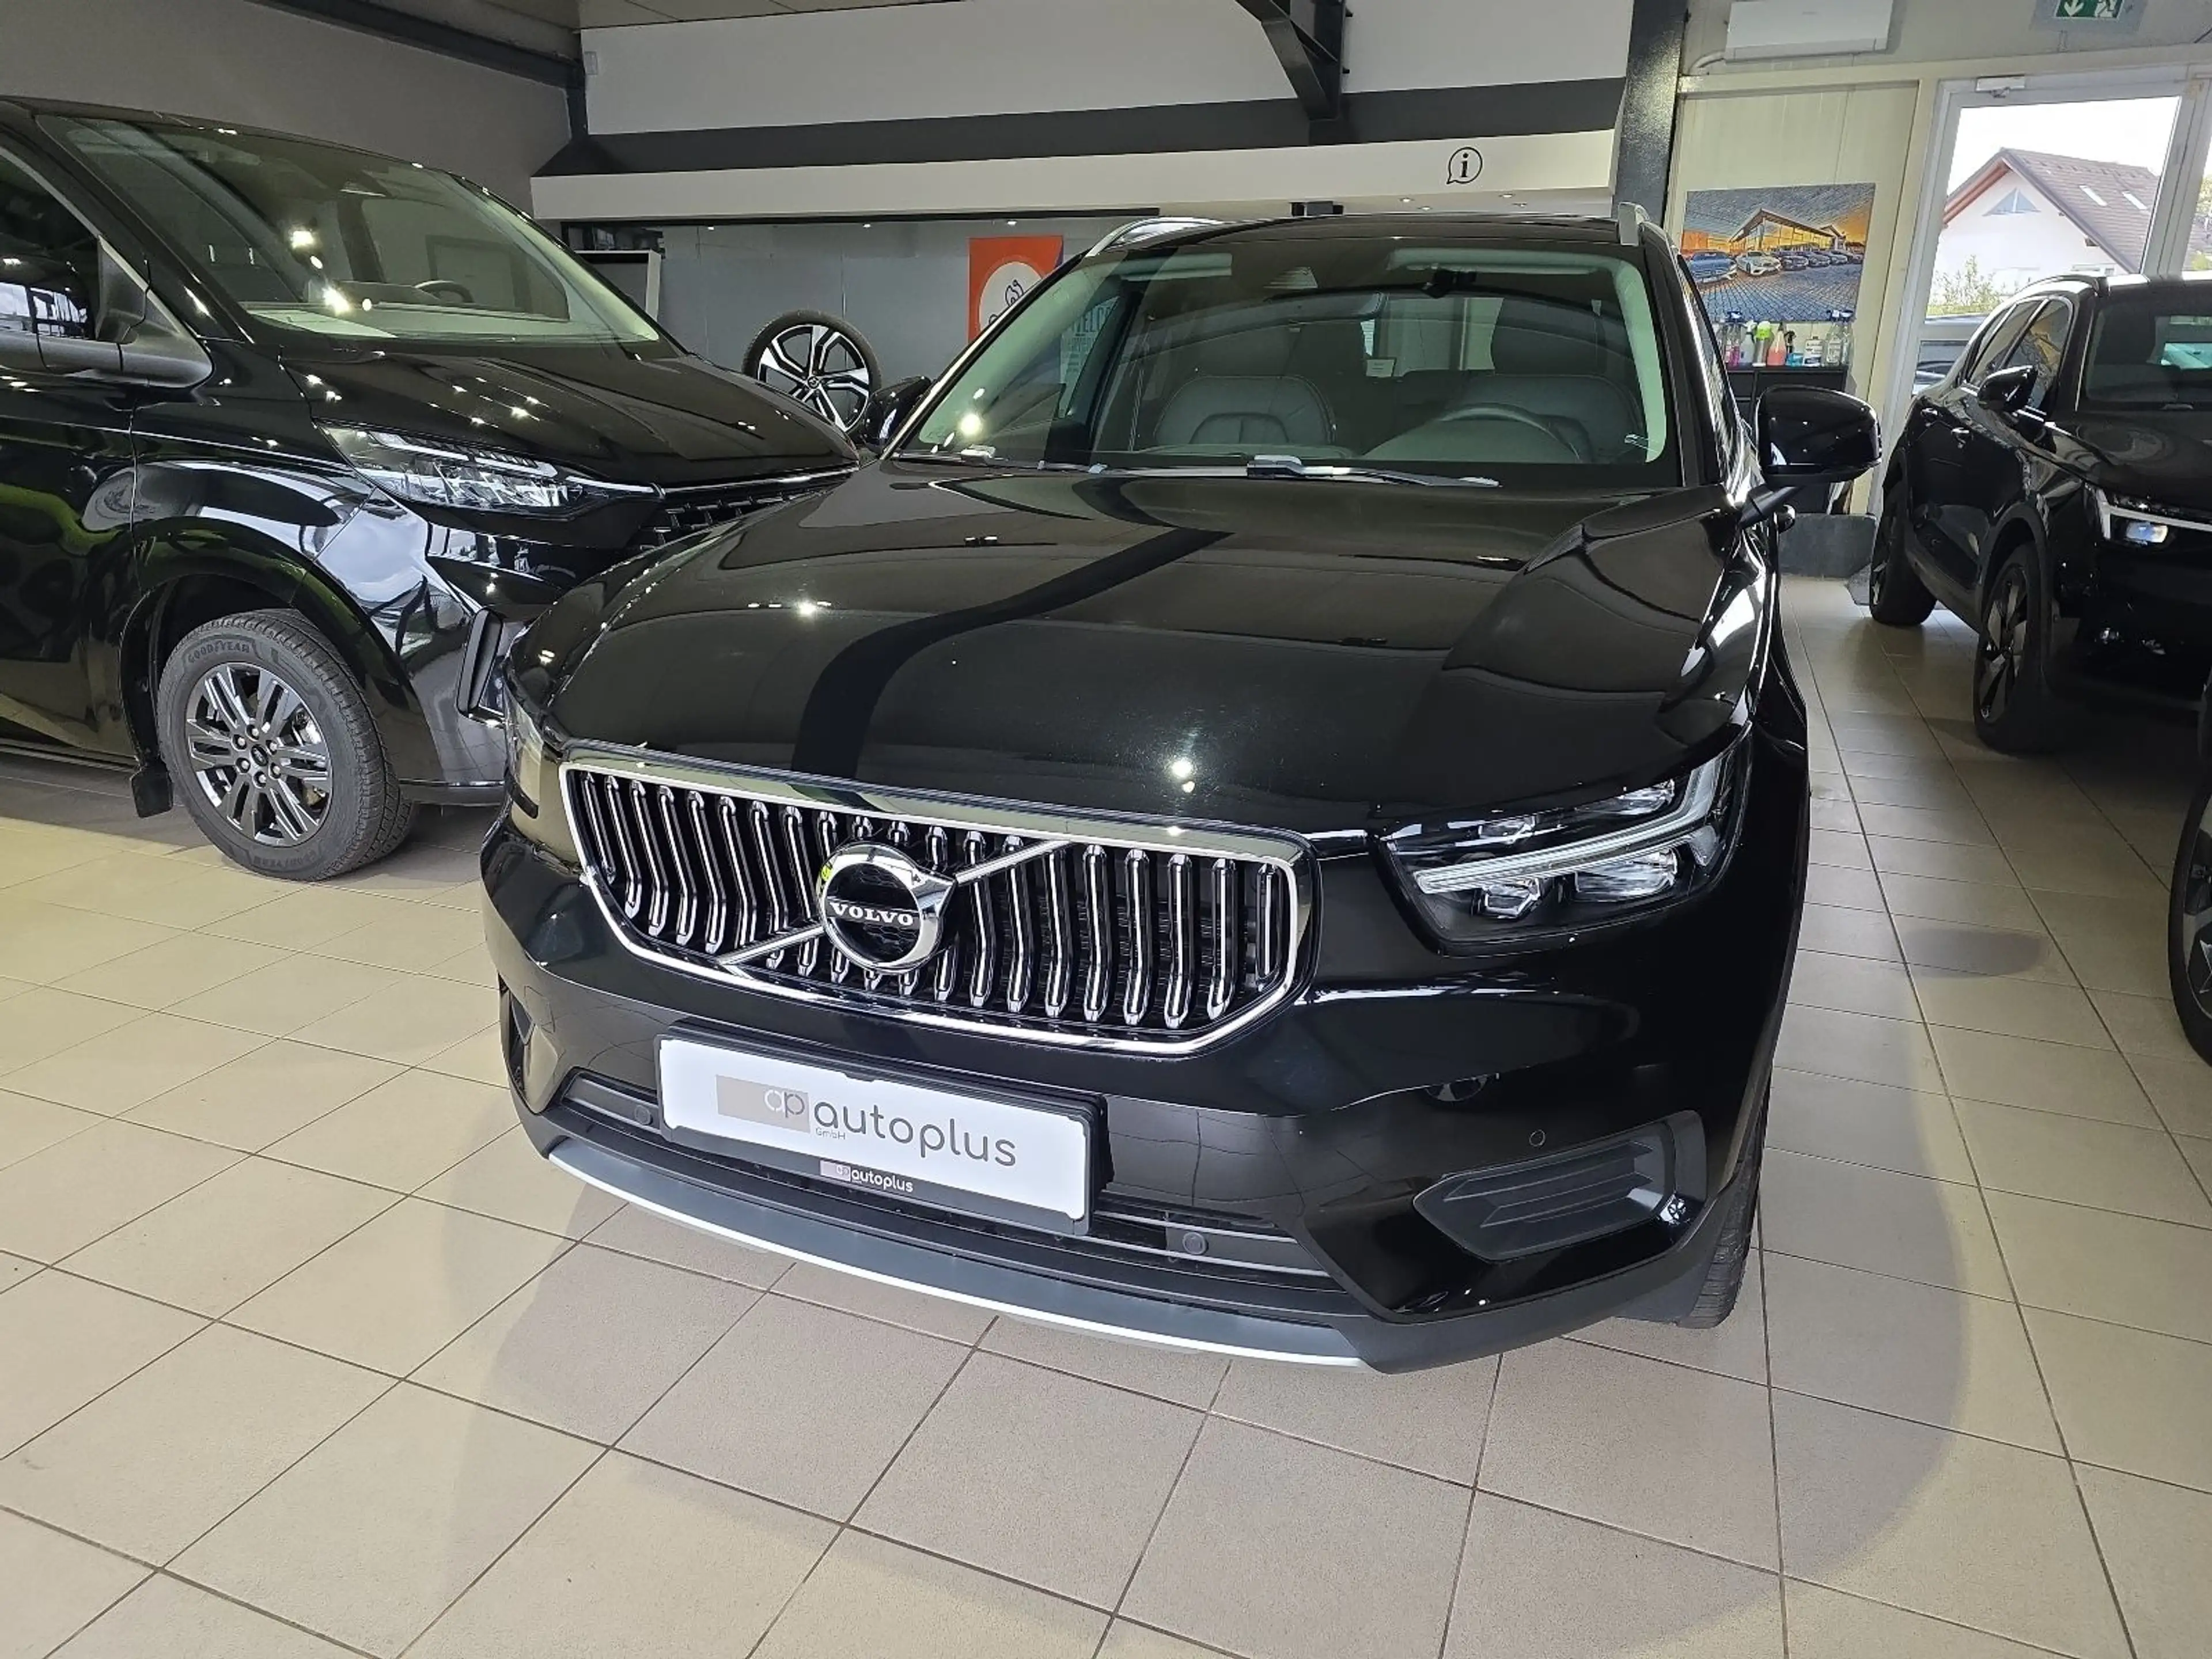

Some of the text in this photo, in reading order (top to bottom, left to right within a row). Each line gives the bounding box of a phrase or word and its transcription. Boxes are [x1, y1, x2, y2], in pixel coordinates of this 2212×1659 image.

[188, 640, 249, 662] GOODYEAR
[828, 902, 914, 926] VOLVO
[814, 1101, 1016, 1166] autoplus
[815, 1128, 846, 1140] GmbH
[851, 1169, 914, 1192] autoplus
